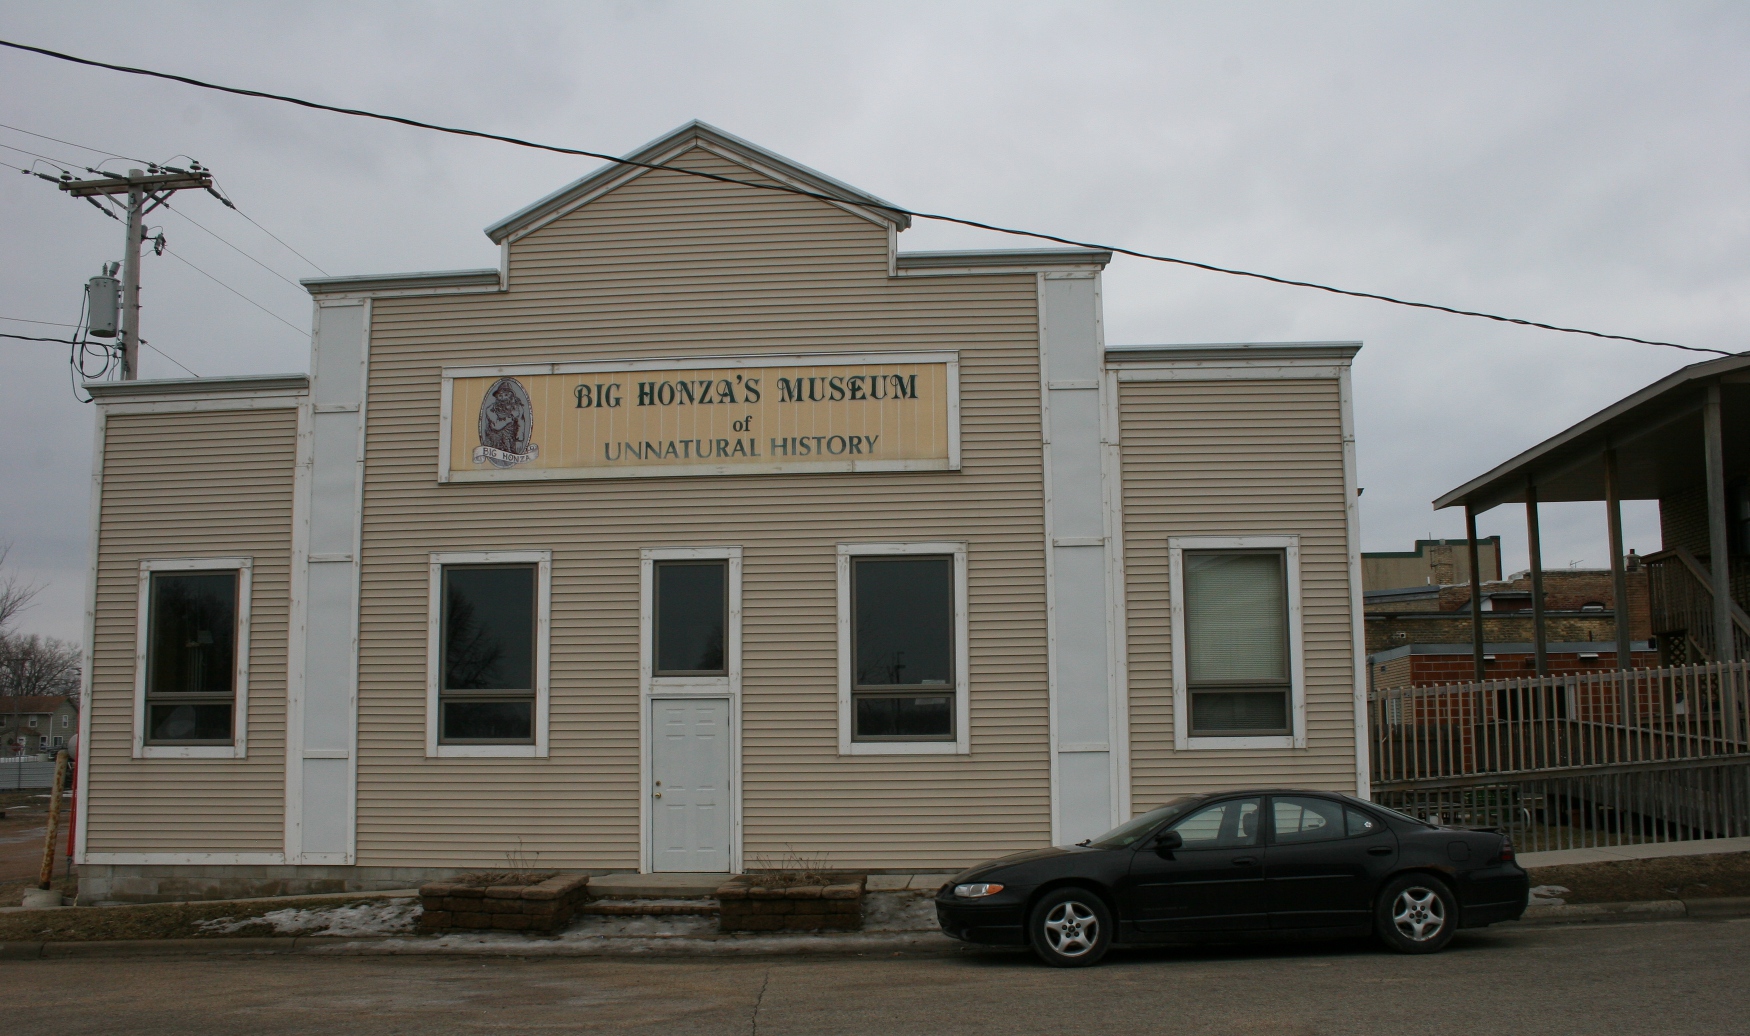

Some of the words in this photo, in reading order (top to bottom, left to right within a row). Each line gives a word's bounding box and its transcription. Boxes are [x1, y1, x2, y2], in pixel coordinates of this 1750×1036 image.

[574, 383, 623, 409] BIG
[637, 374, 761, 407] HONZA'S
[777, 374, 918, 404] MUSEUM
[732, 415, 753, 432] of
[482, 446, 498, 458] BIG
[502, 453, 532, 463] HONZA
[604, 438, 762, 462] UNNATURAL
[770, 434, 880, 457] HISTORY
